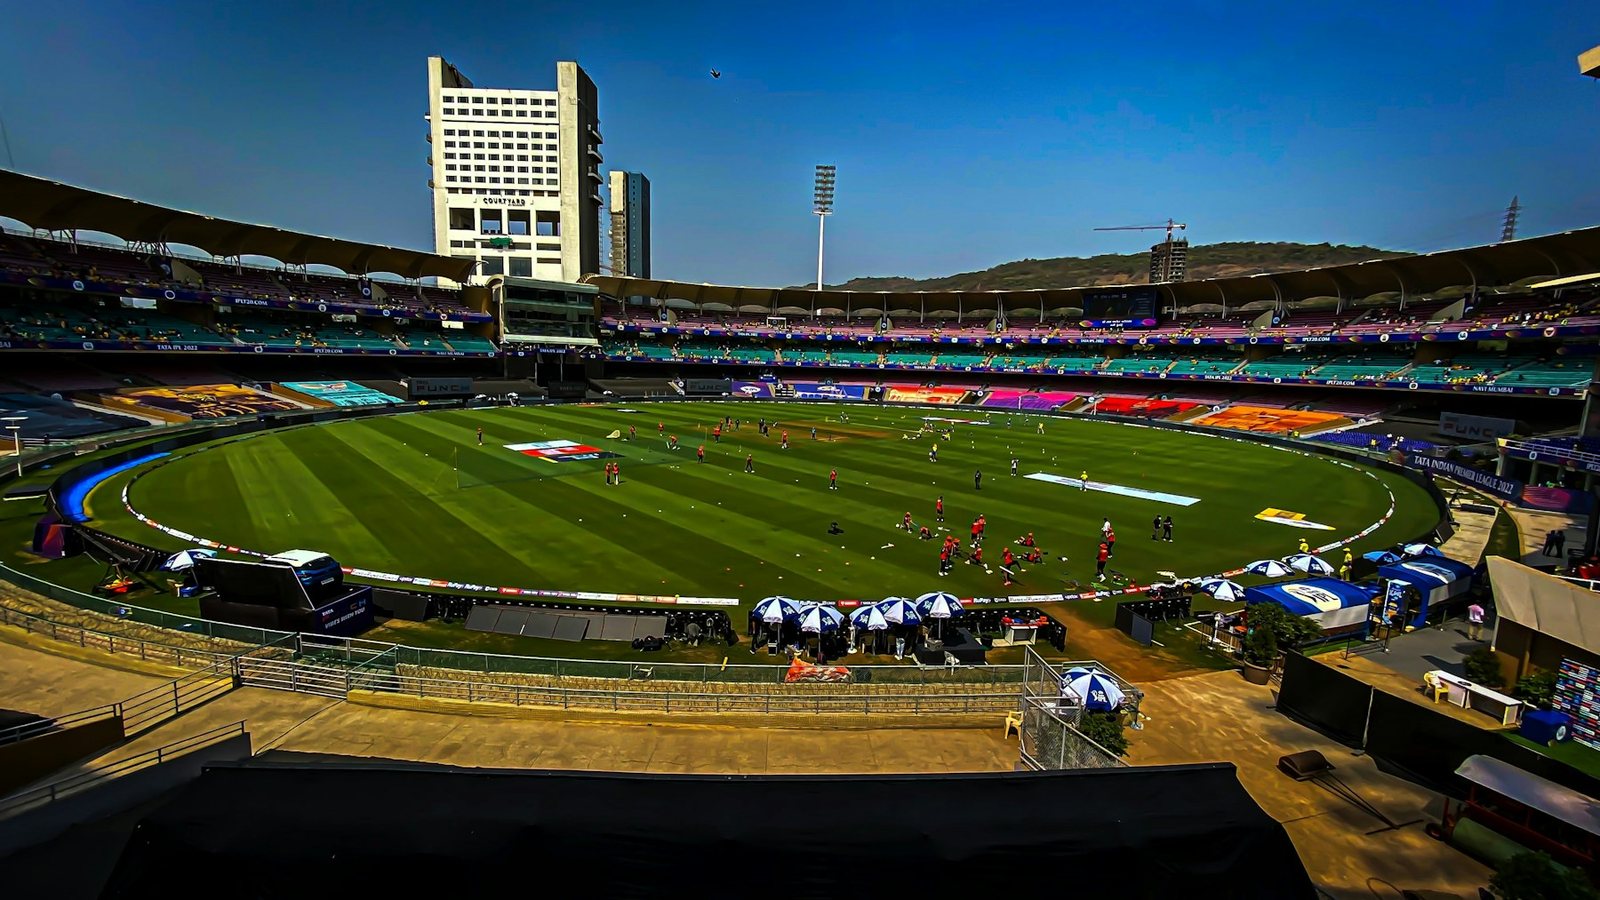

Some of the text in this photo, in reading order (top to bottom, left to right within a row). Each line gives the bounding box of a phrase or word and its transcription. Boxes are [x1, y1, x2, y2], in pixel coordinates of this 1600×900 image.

[483, 197, 526, 206] COURTYARD
[1414, 455, 1514, 495] TATA INDIAN PREMIER LEAGUE 2022
